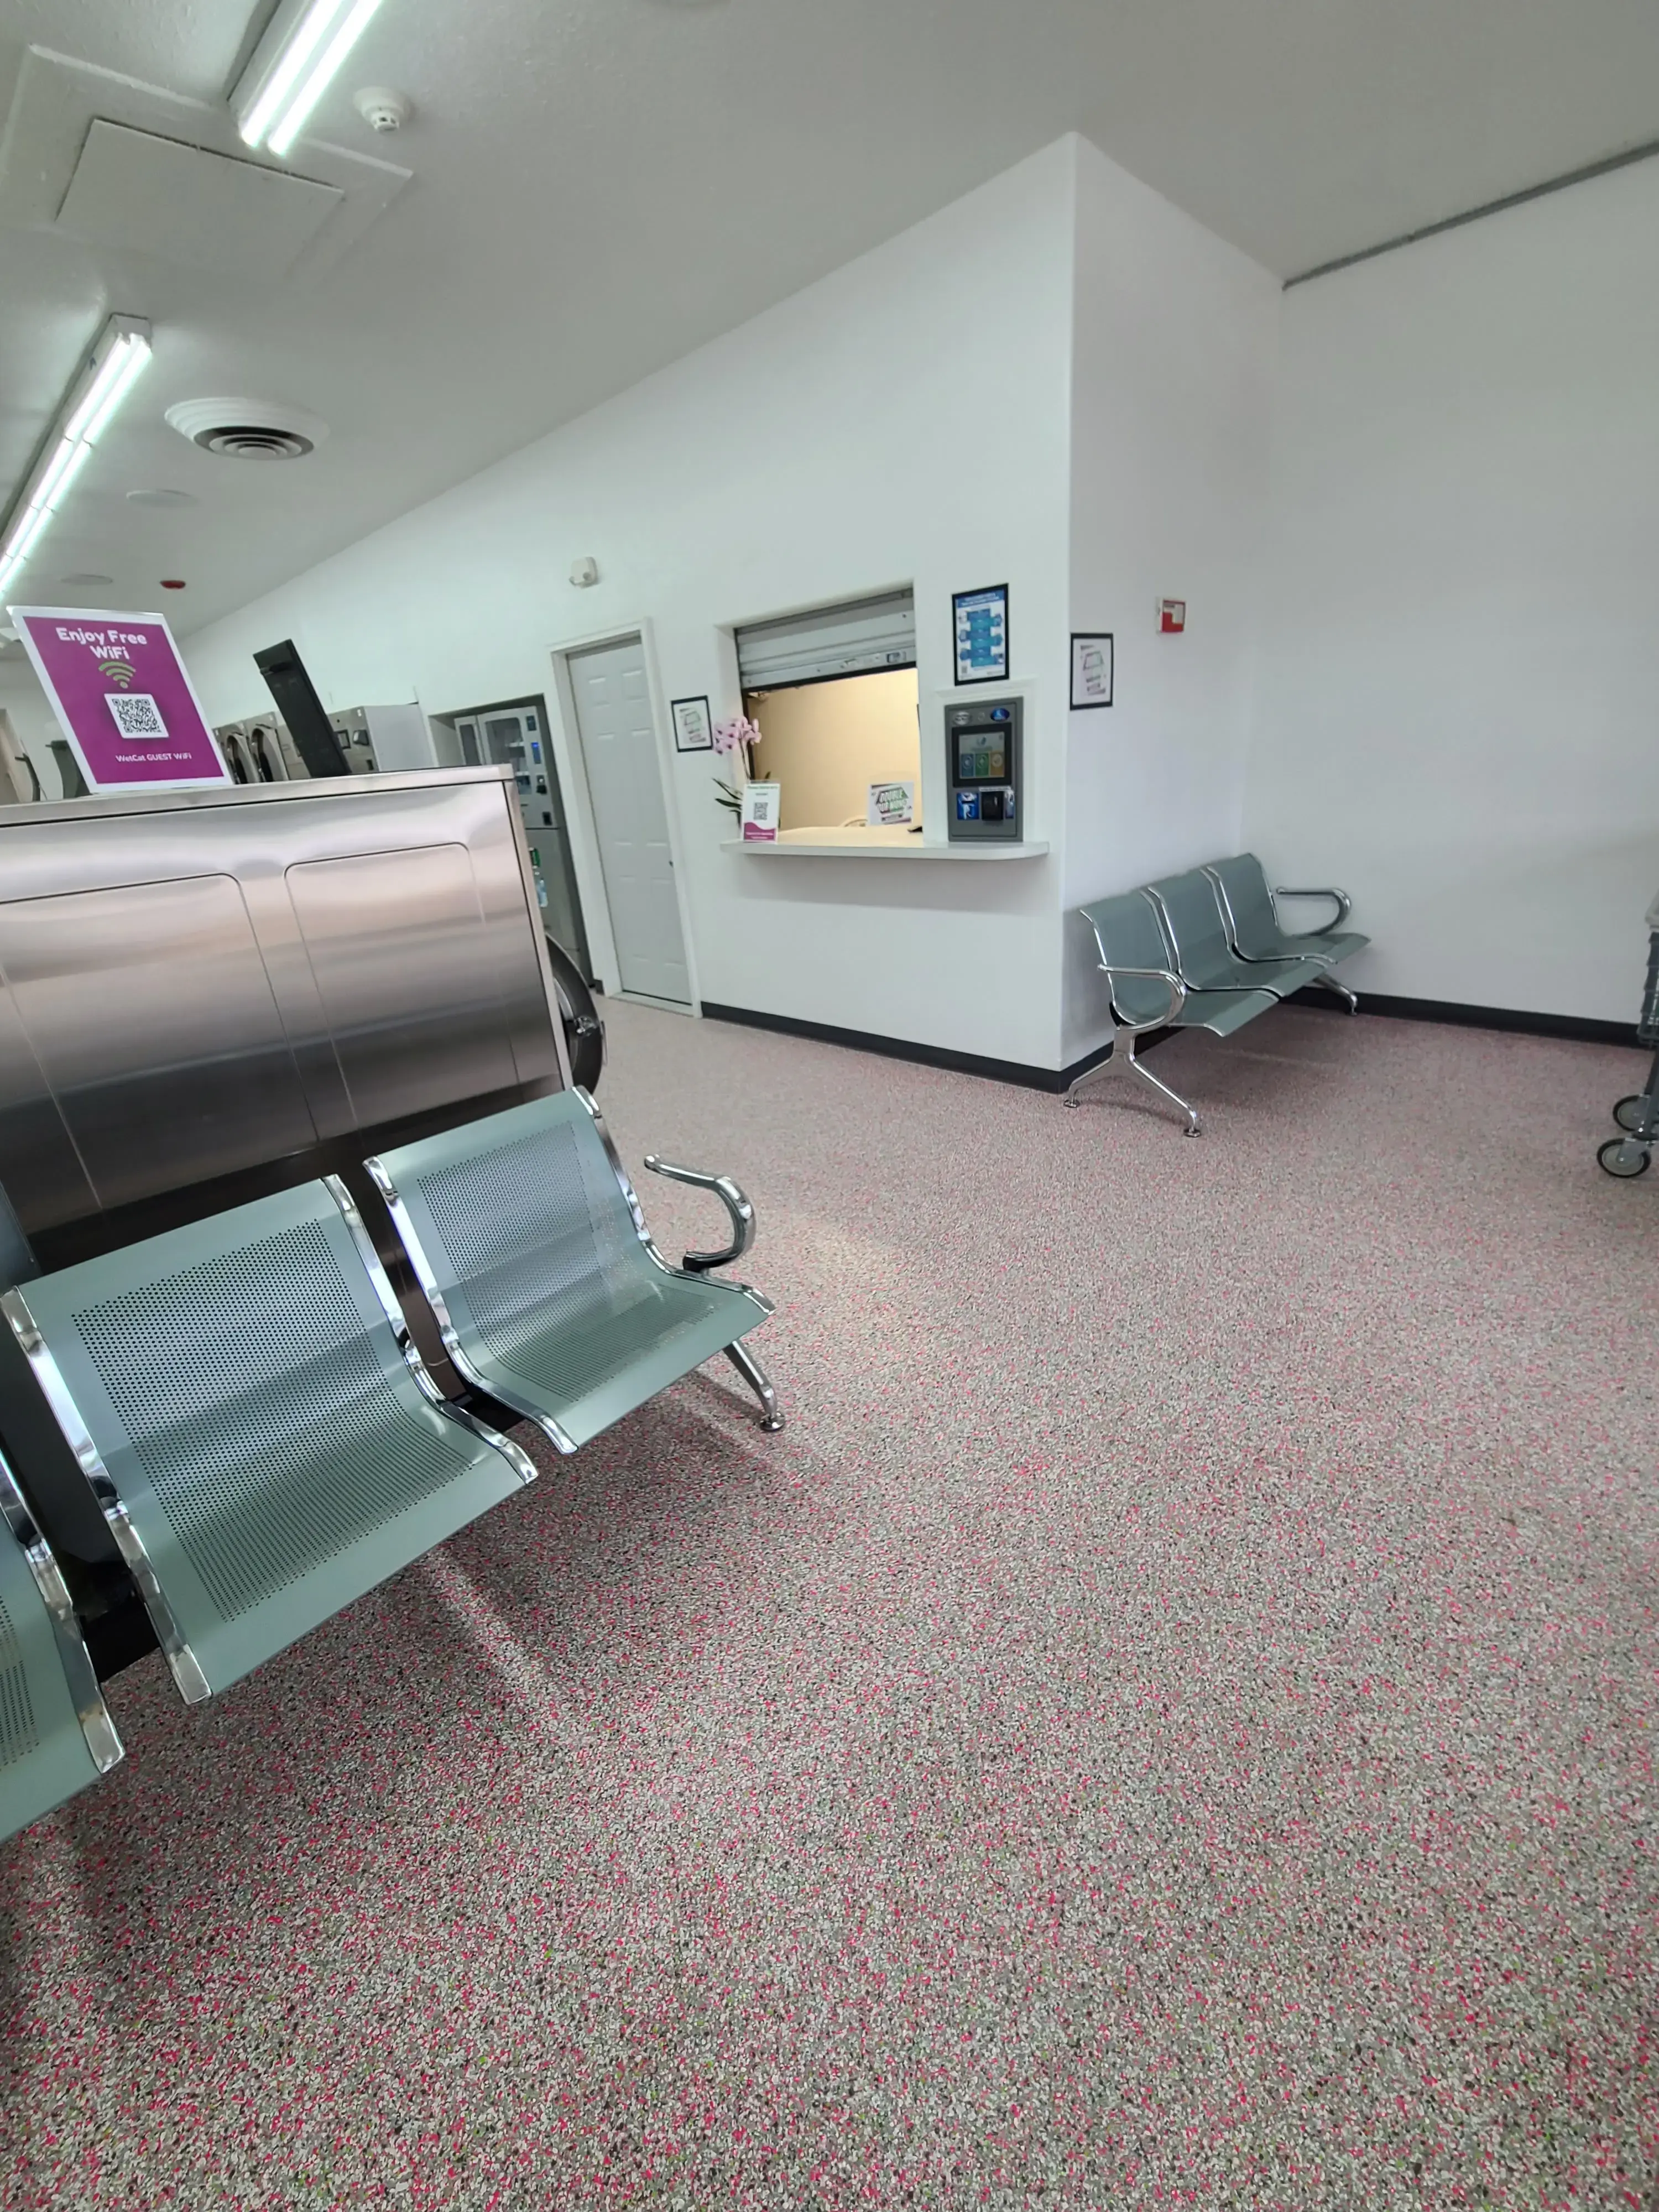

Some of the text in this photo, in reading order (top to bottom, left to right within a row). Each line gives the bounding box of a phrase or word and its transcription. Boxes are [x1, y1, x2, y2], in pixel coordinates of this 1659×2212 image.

[55, 627, 148, 645] Enjoy Free
[89, 645, 131, 660] WiFi
[146, 752, 172, 761] GUEST
[173, 752, 192, 760] WiFi
